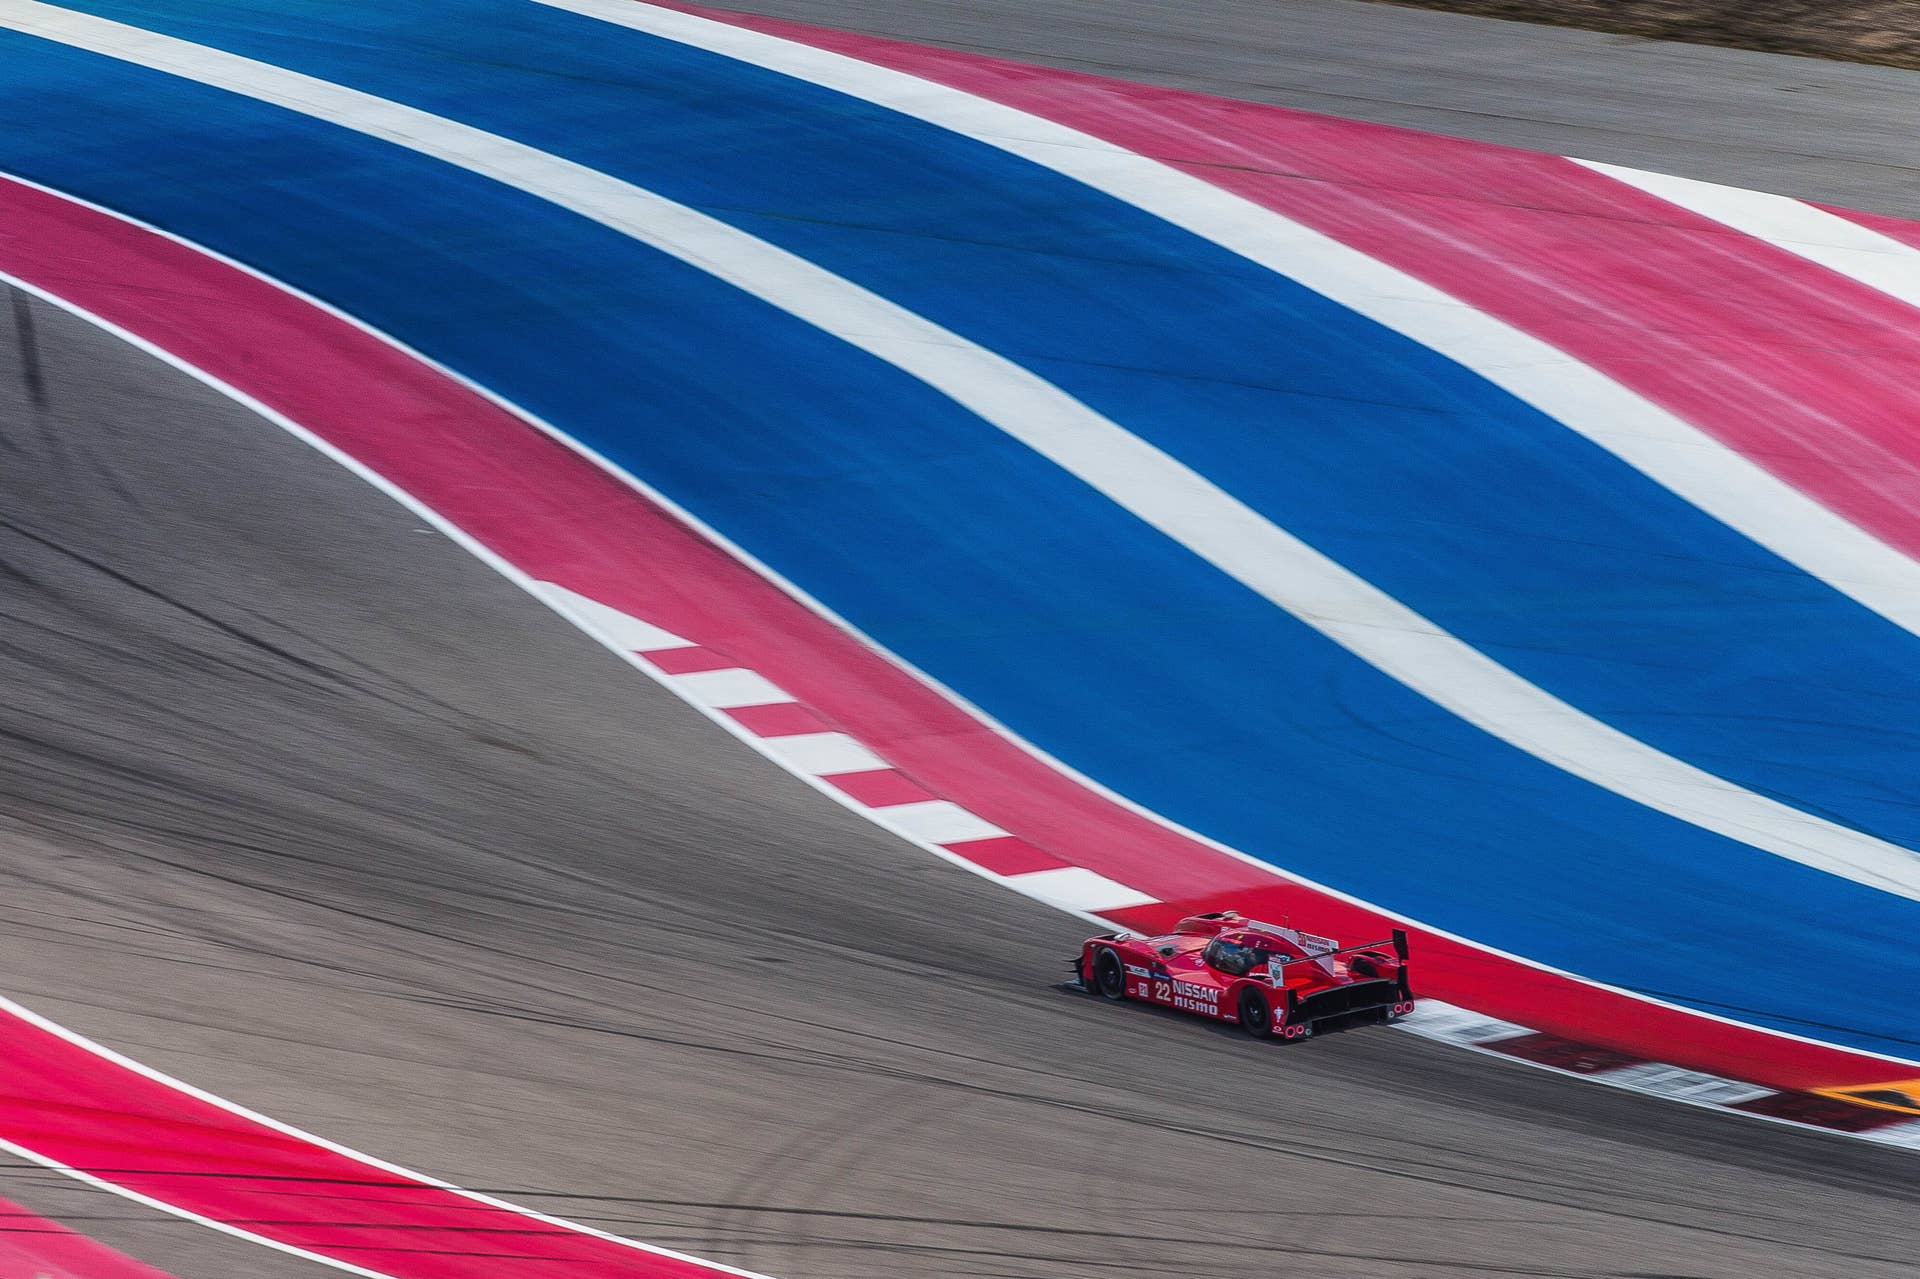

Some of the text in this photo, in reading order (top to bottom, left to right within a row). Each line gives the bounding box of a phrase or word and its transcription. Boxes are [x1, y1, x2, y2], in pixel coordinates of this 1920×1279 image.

[1155, 981, 1171, 1001] 22
[1172, 980, 1218, 1003] NISSAN
[1174, 995, 1218, 1016] nismo
